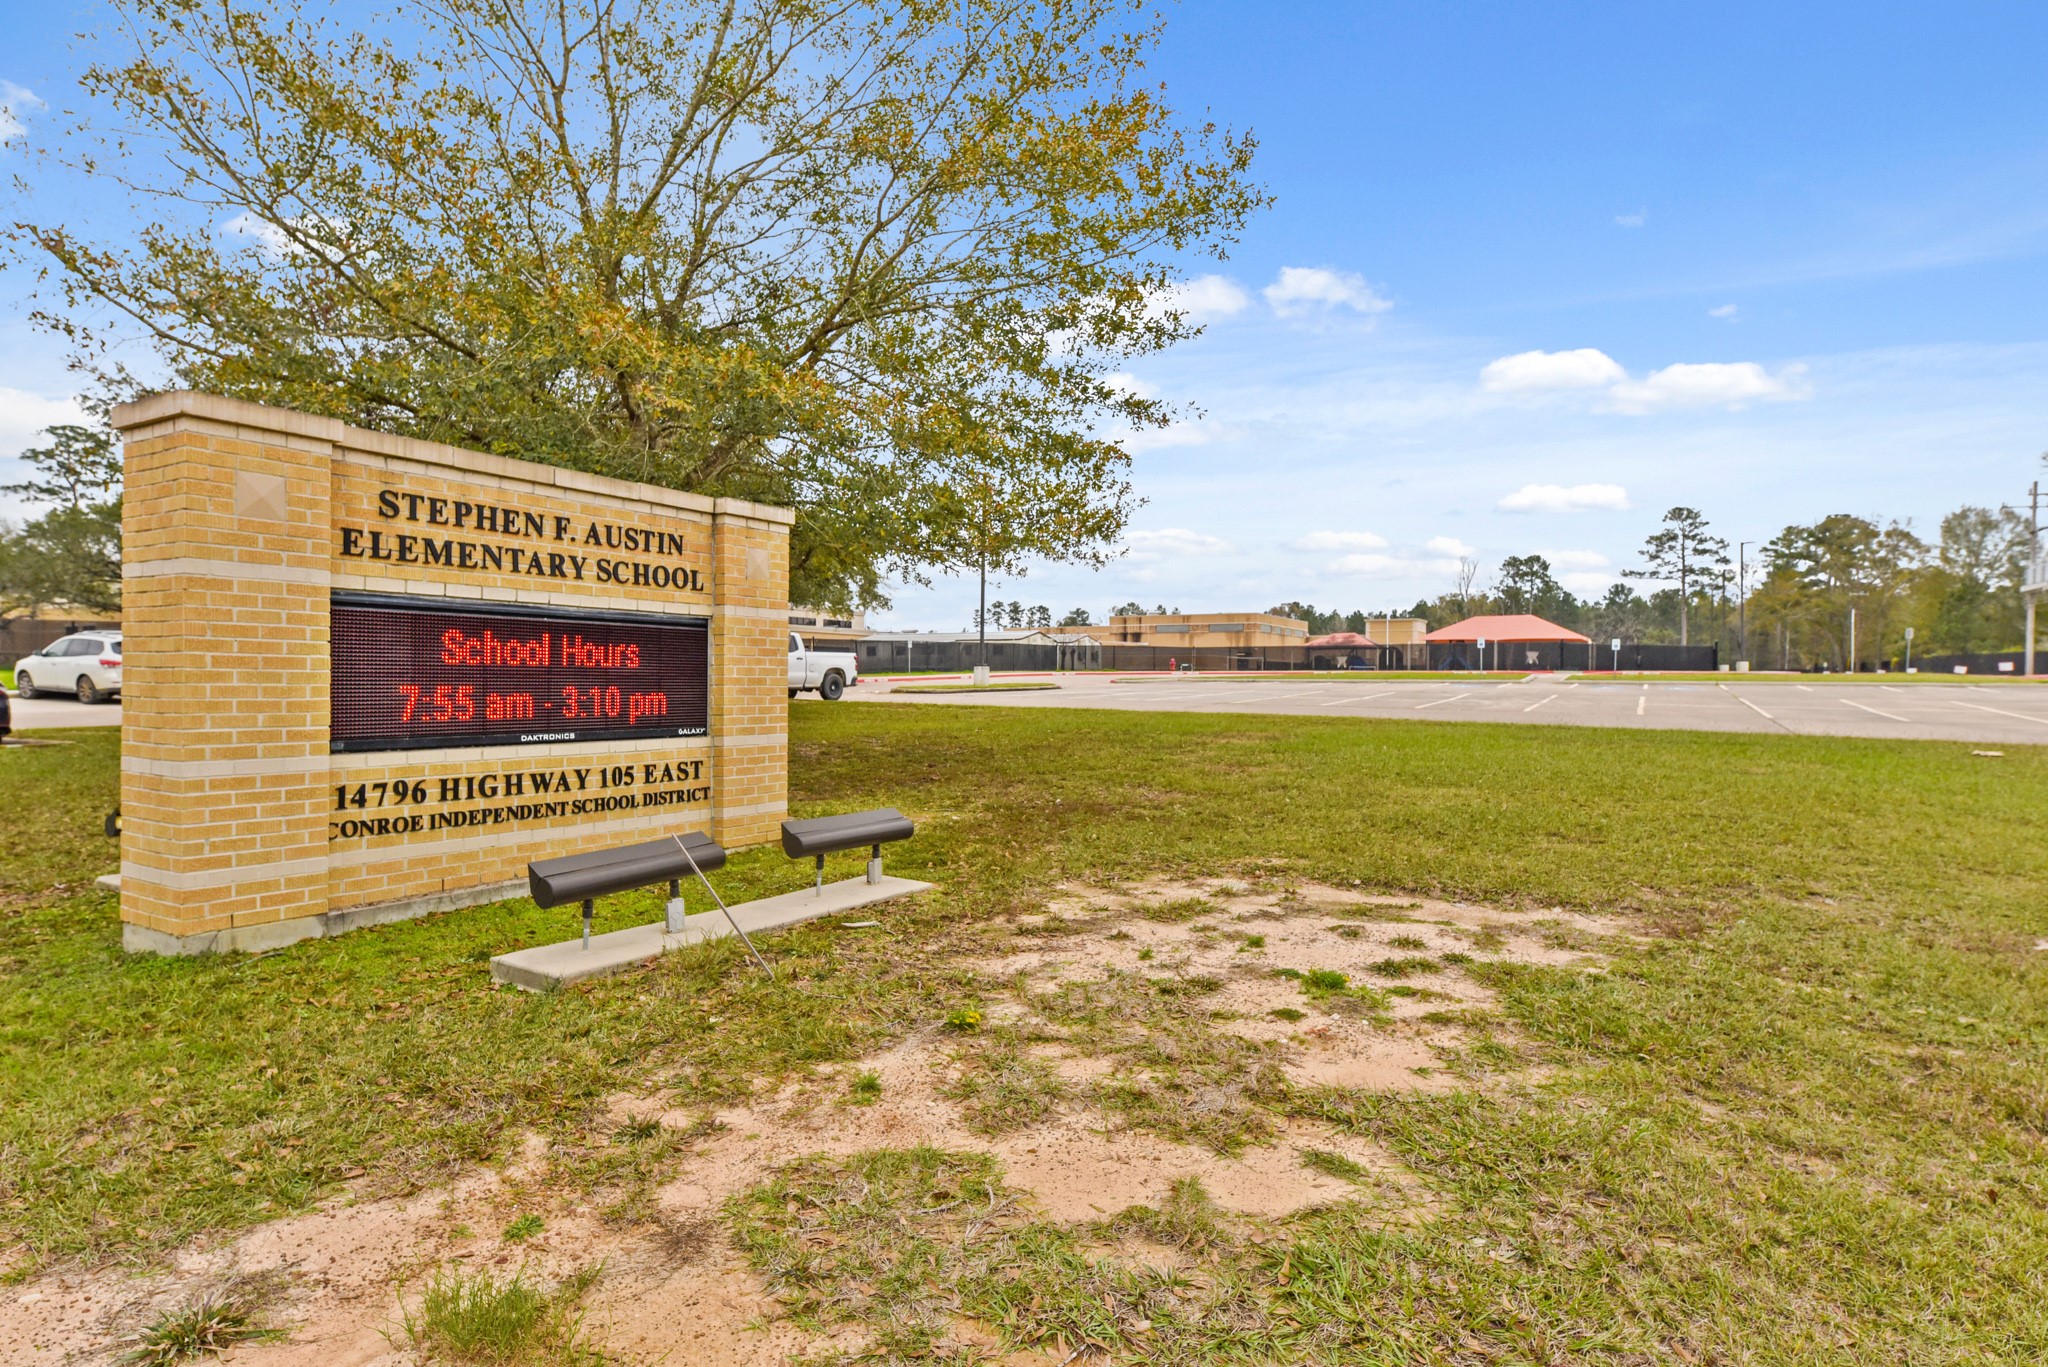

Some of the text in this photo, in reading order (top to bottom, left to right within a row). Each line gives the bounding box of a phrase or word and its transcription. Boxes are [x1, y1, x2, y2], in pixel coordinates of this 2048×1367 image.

[378, 489, 685, 556] STEPHEN F. AUSTIN
[339, 527, 704, 592] ELEMENTARY SCHOOL
[441, 629, 640, 668] School Hours
[399, 684, 475, 721] 7:55
[485, 692, 534, 720] am
[563, 685, 620, 718] 3:10
[629, 690, 668, 725] pm
[521, 732, 576, 742] DAKTRONICS
[678, 727, 706, 736] GALAXY
[335, 760, 704, 811] 14796 HIGHWAY 105 EAST
[328, 786, 711, 841] CONROE INDEPENDENT SCHOOL DISTRICT
